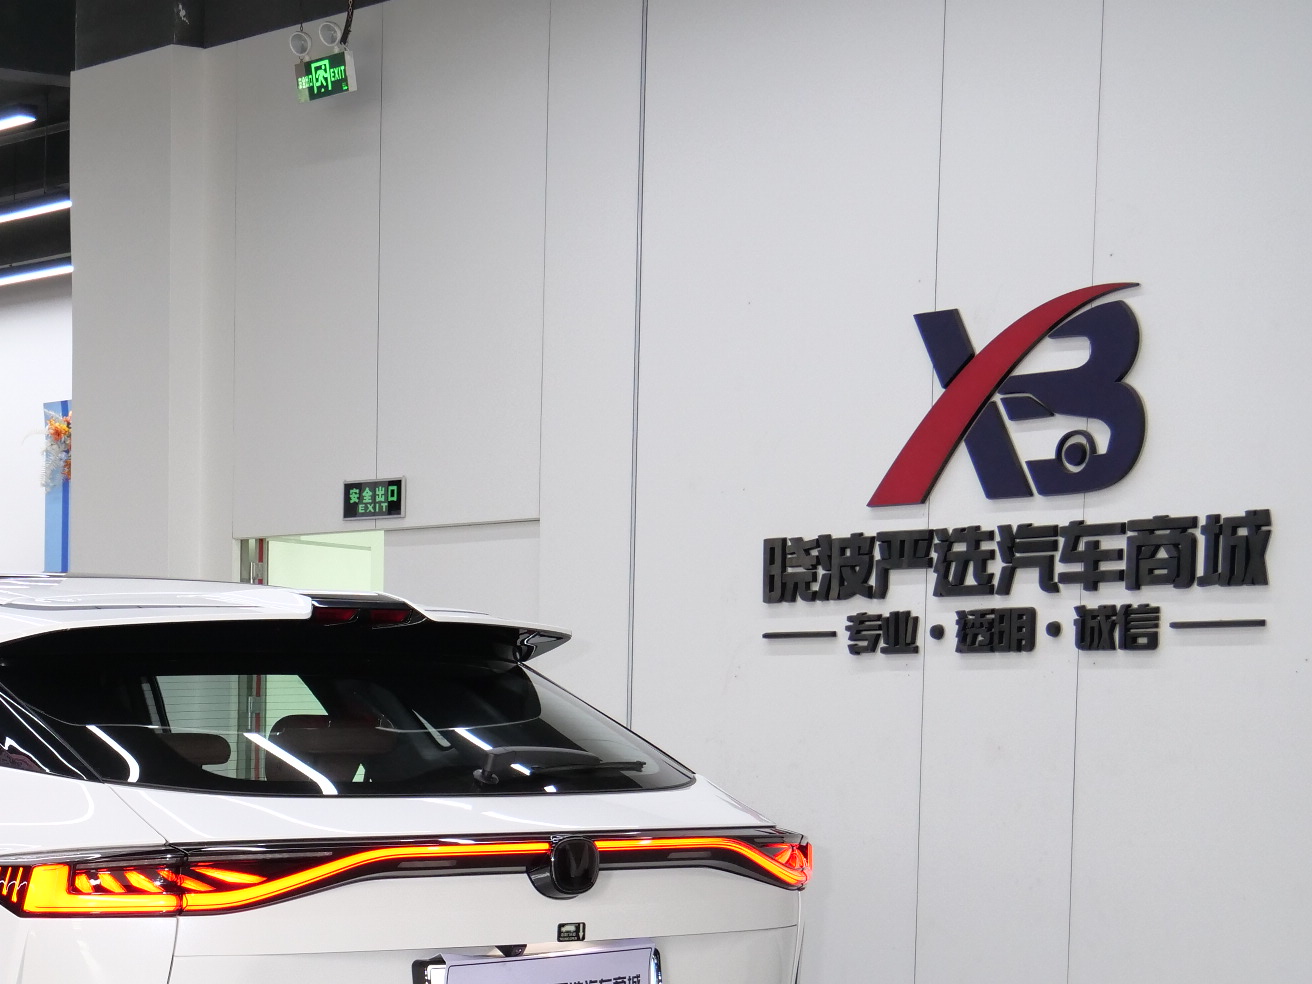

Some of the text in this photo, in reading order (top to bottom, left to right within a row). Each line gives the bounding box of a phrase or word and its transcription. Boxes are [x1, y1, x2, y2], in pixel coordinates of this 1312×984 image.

[330, 66, 345, 81] EXIT
[349, 486, 397, 503] 安全出口
[358, 503, 388, 513] EXIT
[762, 509, 1272, 604] 晓波严选汽车商城
